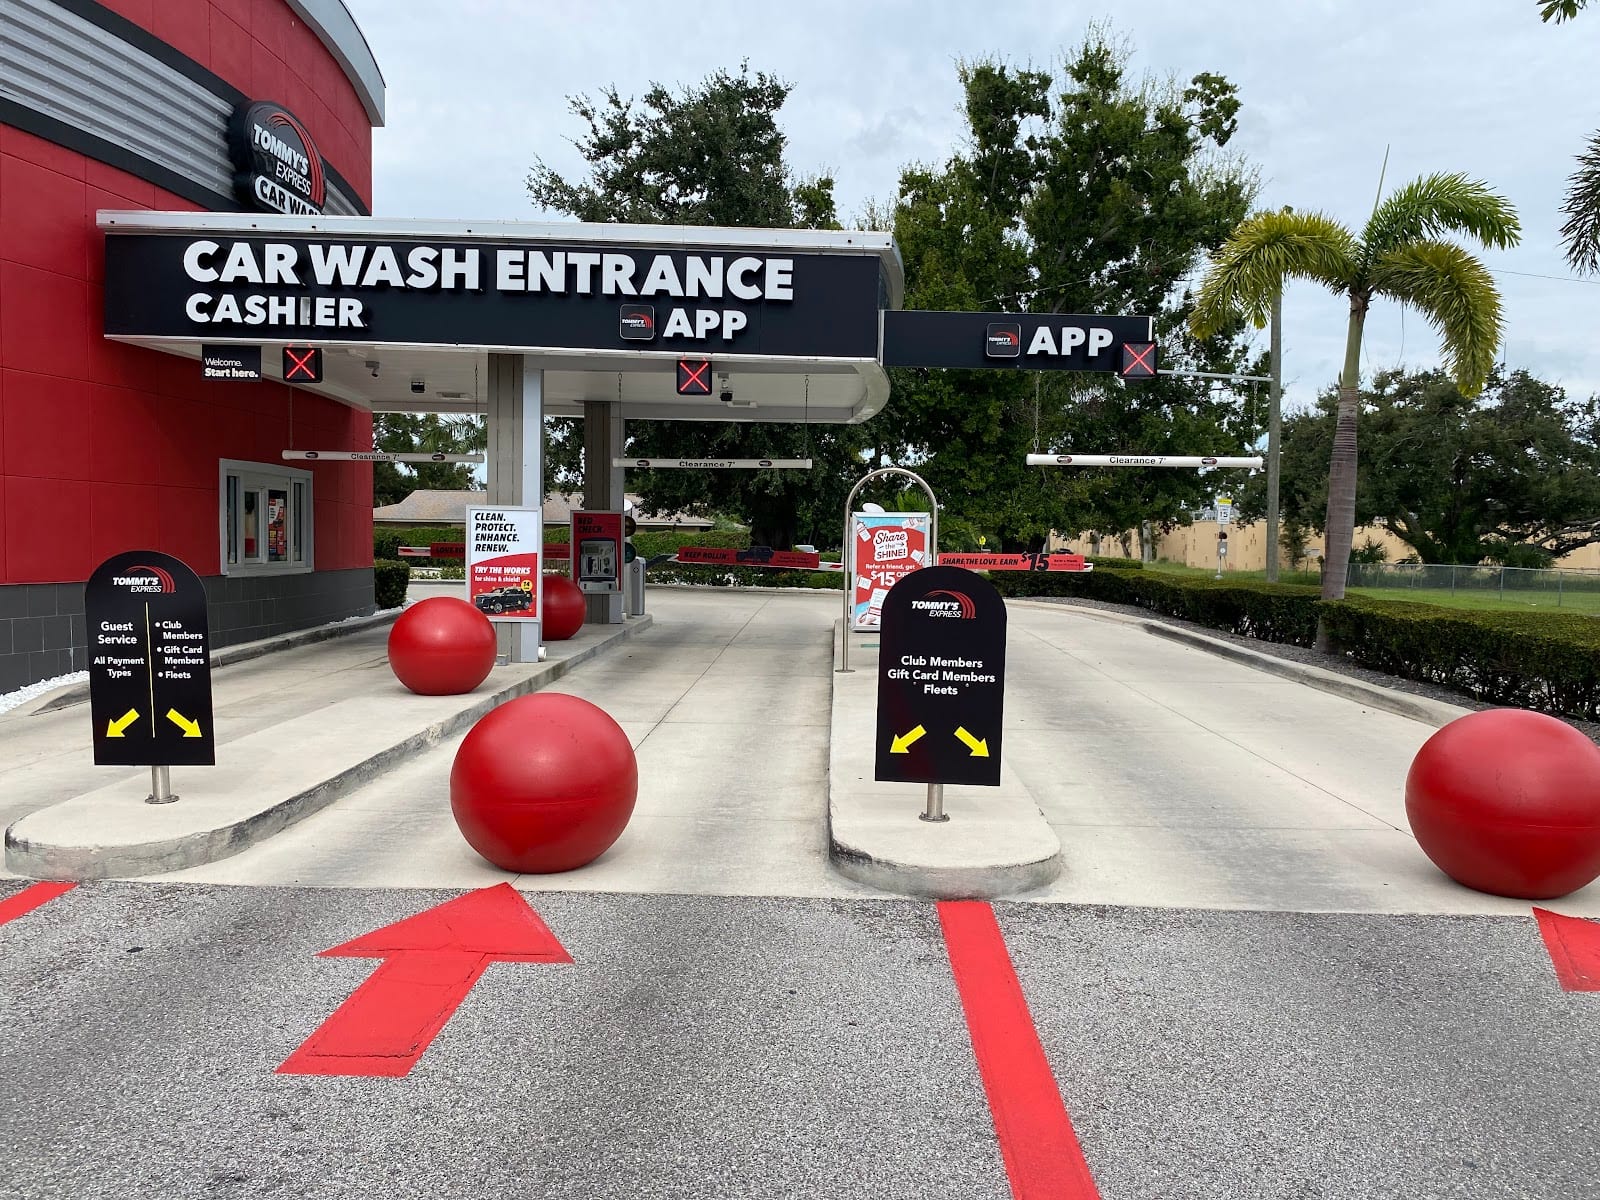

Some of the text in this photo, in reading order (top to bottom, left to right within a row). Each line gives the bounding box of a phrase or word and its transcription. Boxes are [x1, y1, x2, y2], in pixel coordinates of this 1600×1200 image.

[253, 123, 308, 176] TOMMY'S
[275, 161, 311, 196] EXPRESS
[259, 179, 317, 215] CAR WA
[183, 241, 795, 302] CAR WASH ENTRANCE
[186, 292, 365, 328] CASHIER
[663, 308, 748, 340] APP
[1026, 326, 1114, 357] APP
[205, 357, 243, 367] Welcome.
[204, 368, 259, 378] Start here.
[351, 453, 391, 461] Clearance
[1109, 456, 1156, 464] Clearance
[475, 512, 506, 521] CLEAN.
[475, 523, 517, 532] PROTECT.
[475, 533, 520, 542] ENHANCE.
[875, 532, 906, 545] Share
[475, 543, 510, 553] RENEW.
[876, 548, 907, 560] SHINE!
[942, 557, 965, 566] SHARE
[965, 558, 978, 566] THE
[1000, 558, 1019, 566] EARN
[1021, 551, 1050, 571] $15
[475, 566, 531, 574] TRY THE WORKS
[112, 577, 159, 586] TOMMY'S
[871, 570, 896, 587] $15
[130, 585, 162, 593] EXPRESS
[911, 601, 959, 610] TOMMY'S
[929, 609, 962, 618] EXPRESS
[100, 621, 133, 632] Guest
[162, 620, 182, 630] Club
[97, 634, 138, 645] Service
[163, 631, 203, 640] Members
[163, 645, 203, 654] Gift Card
[94, 656, 145, 667] All Payment
[164, 656, 205, 665] Members
[901, 655, 983, 669] Club Members
[107, 668, 132, 678] Types
[165, 670, 191, 679] Fleets
[887, 668, 996, 684] Gift Card Members
[924, 684, 958, 696] Fleets
